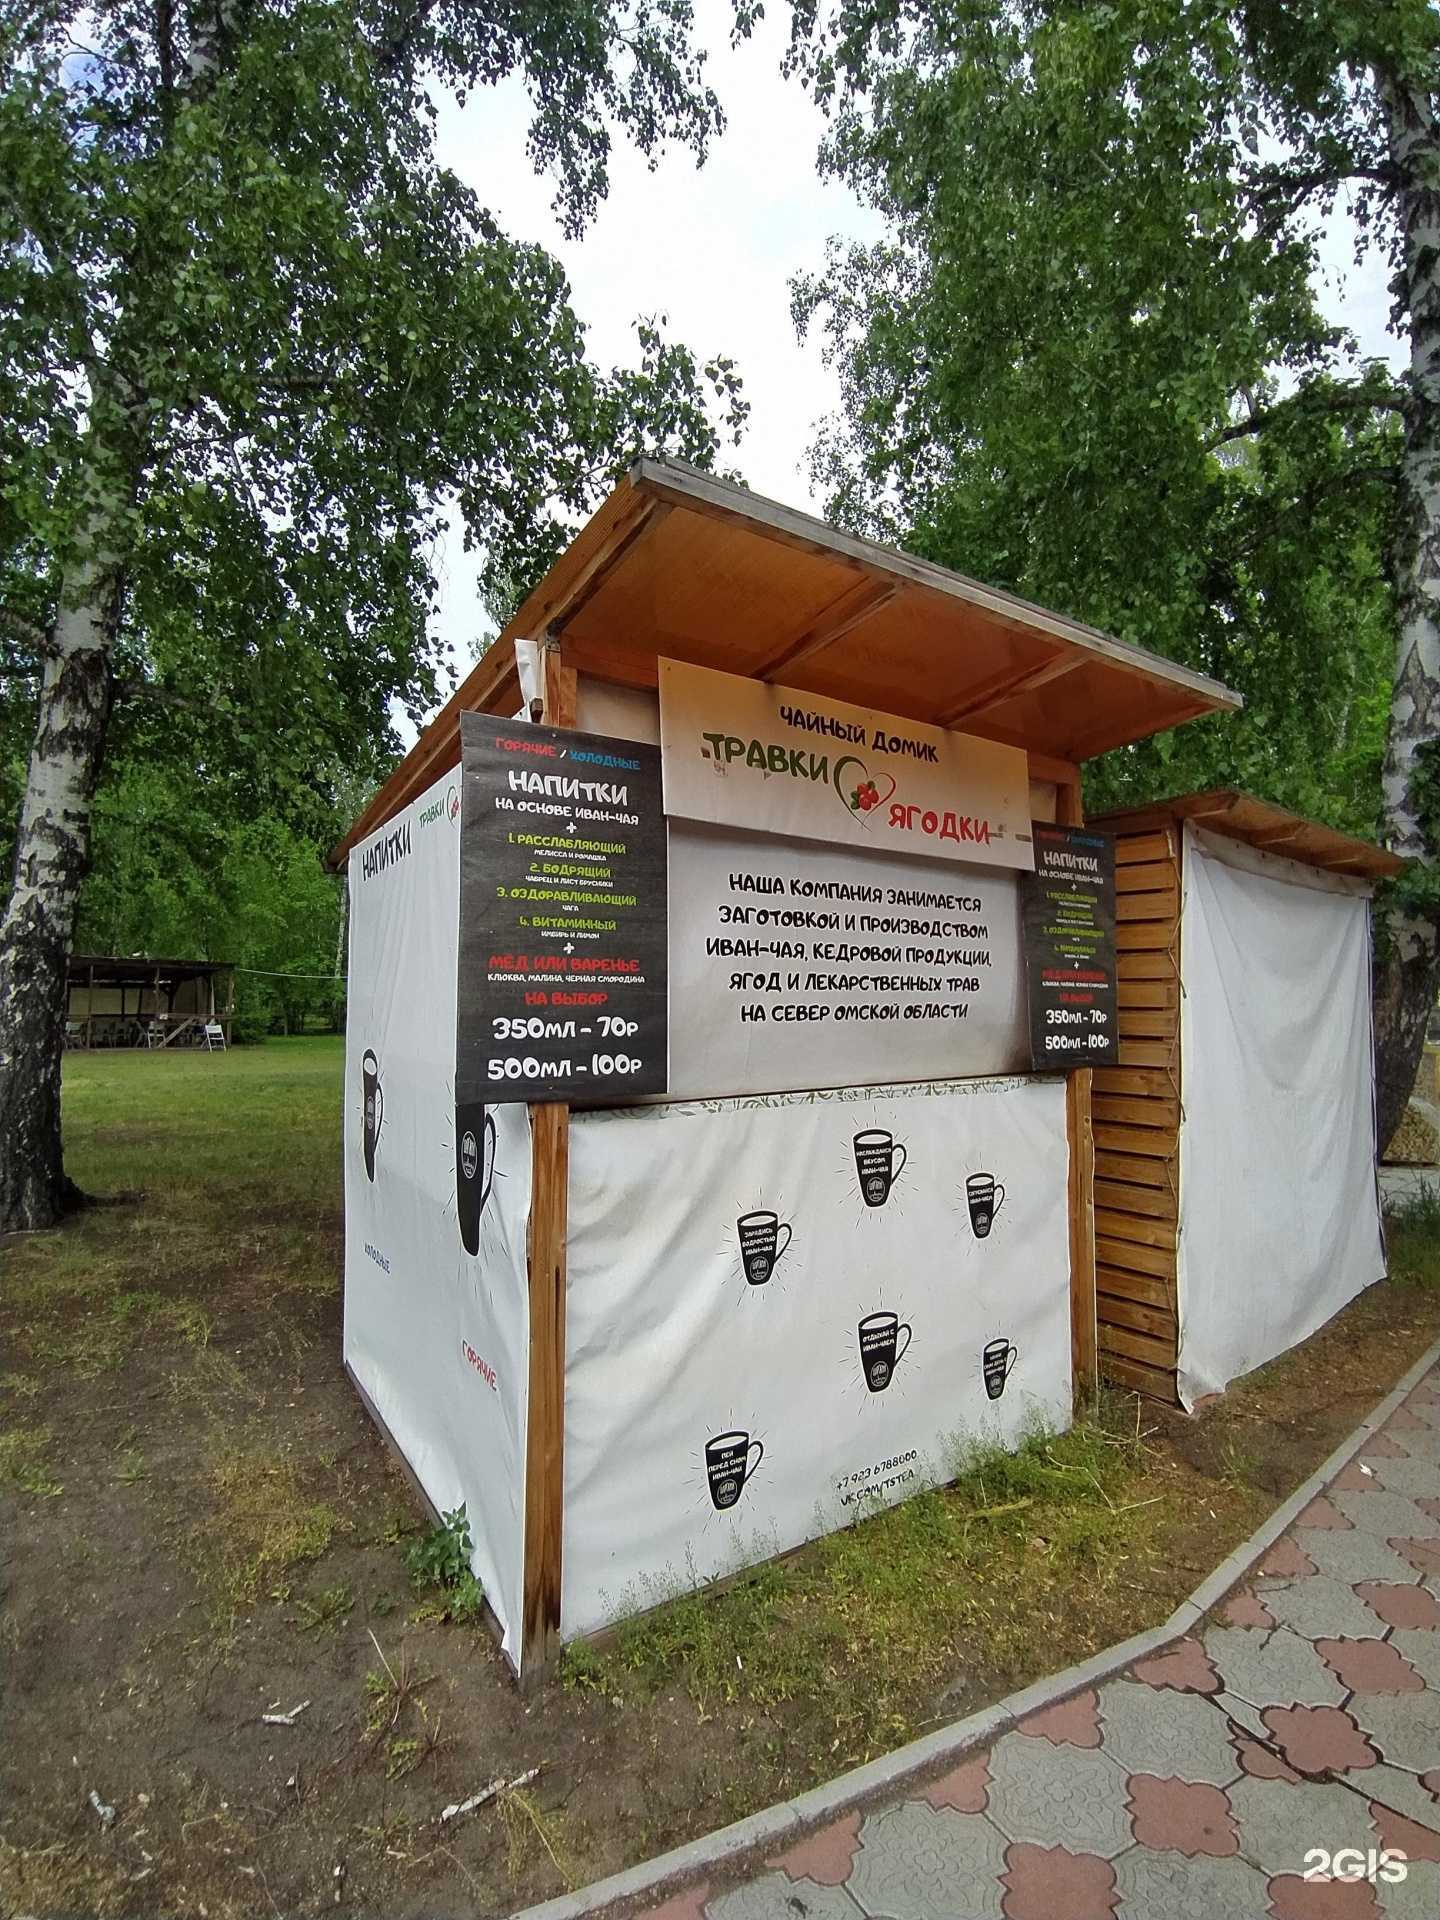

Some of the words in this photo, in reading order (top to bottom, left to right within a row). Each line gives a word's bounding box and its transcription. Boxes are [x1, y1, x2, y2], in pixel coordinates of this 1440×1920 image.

[779, 705, 867, 746] ЧАЙНЫЙ
[872, 731, 939, 763] ДОМИК
[495, 736, 557, 757] ГОРЯЧИЕ
[569, 750, 640, 770] ХОЛОДНЫЕ
[703, 732, 829, 784] ТРАВКИ
[508, 770, 628, 806] НАПИТКИ
[419, 798, 445, 829] ТРАВКИ
[495, 797, 514, 811] НА
[517, 801, 572, 817] ОСНОВЕ
[575, 809, 639, 825] ИВАН-ЧАЯ
[888, 803, 990, 845] ЯГОДКИ
[362, 819, 411, 881] НАПИТКИ
[517, 834, 626, 854] РАССЛАБЛЯЮЩИЙ
[534, 849, 567, 858] МЕЛИССА
[529, 862, 540, 873] 2.
[543, 863, 611, 878] БОДРЯЩИЙ
[1043, 851, 1098, 872] НАПИТКИ
[525, 875, 552, 884] ЧАБРЕЦ
[496, 887, 508, 898] 3.
[511, 887, 637, 906] ОЗДОРАВЛИВАЮЩИЙ
[729, 873, 785, 895] НАША
[790, 879, 883, 904] КОМПАНИЯ
[887, 889, 982, 913] ЗАНИМАЕТСЯ
[519, 916, 530, 927] 4.
[532, 916, 617, 931] ВИТАМИННЫЙ
[718, 905, 840, 931] ЗАГОТОВКОЙ
[845, 914, 856, 931] И
[860, 916, 989, 939] ПРОИЗВОДСТВОМ
[488, 955, 528, 971] МЕД
[534, 955, 567, 972] ИЛИ
[571, 957, 640, 972] ВАРЕНЬЕ
[706, 938, 809, 962] ИВАН-ЧАЯ,
[813, 942, 901, 963] КЕДРОВОЙ
[906, 946, 992, 968] ПРОДУКЦИИ,
[487, 973, 526, 983] КЛЮКВА,
[528, 974, 564, 983] МАЛИНА,
[565, 975, 596, 983] ЧЕРНАЯ
[597, 975, 645, 984] СМОРОДИНА
[729, 973, 782, 993] ЯГОД
[787, 973, 800, 991] И
[804, 973, 942, 993] ЛЕКАРСТВЕННЫХ
[946, 978, 980, 992] ТРАВ
[524, 991, 547, 1005] НА
[551, 991, 608, 1005] ВЫБОР
[741, 1005, 766, 1022] НА
[772, 1005, 830, 1022] СЕВЕР
[834, 1002, 900, 1021] ОМСКОЙ
[903, 1003, 969, 1020] ОБЛАСТИ
[462, 1339, 497, 1391] ГОРЯЧИЕ
[837, 1477, 849, 1490] +7
